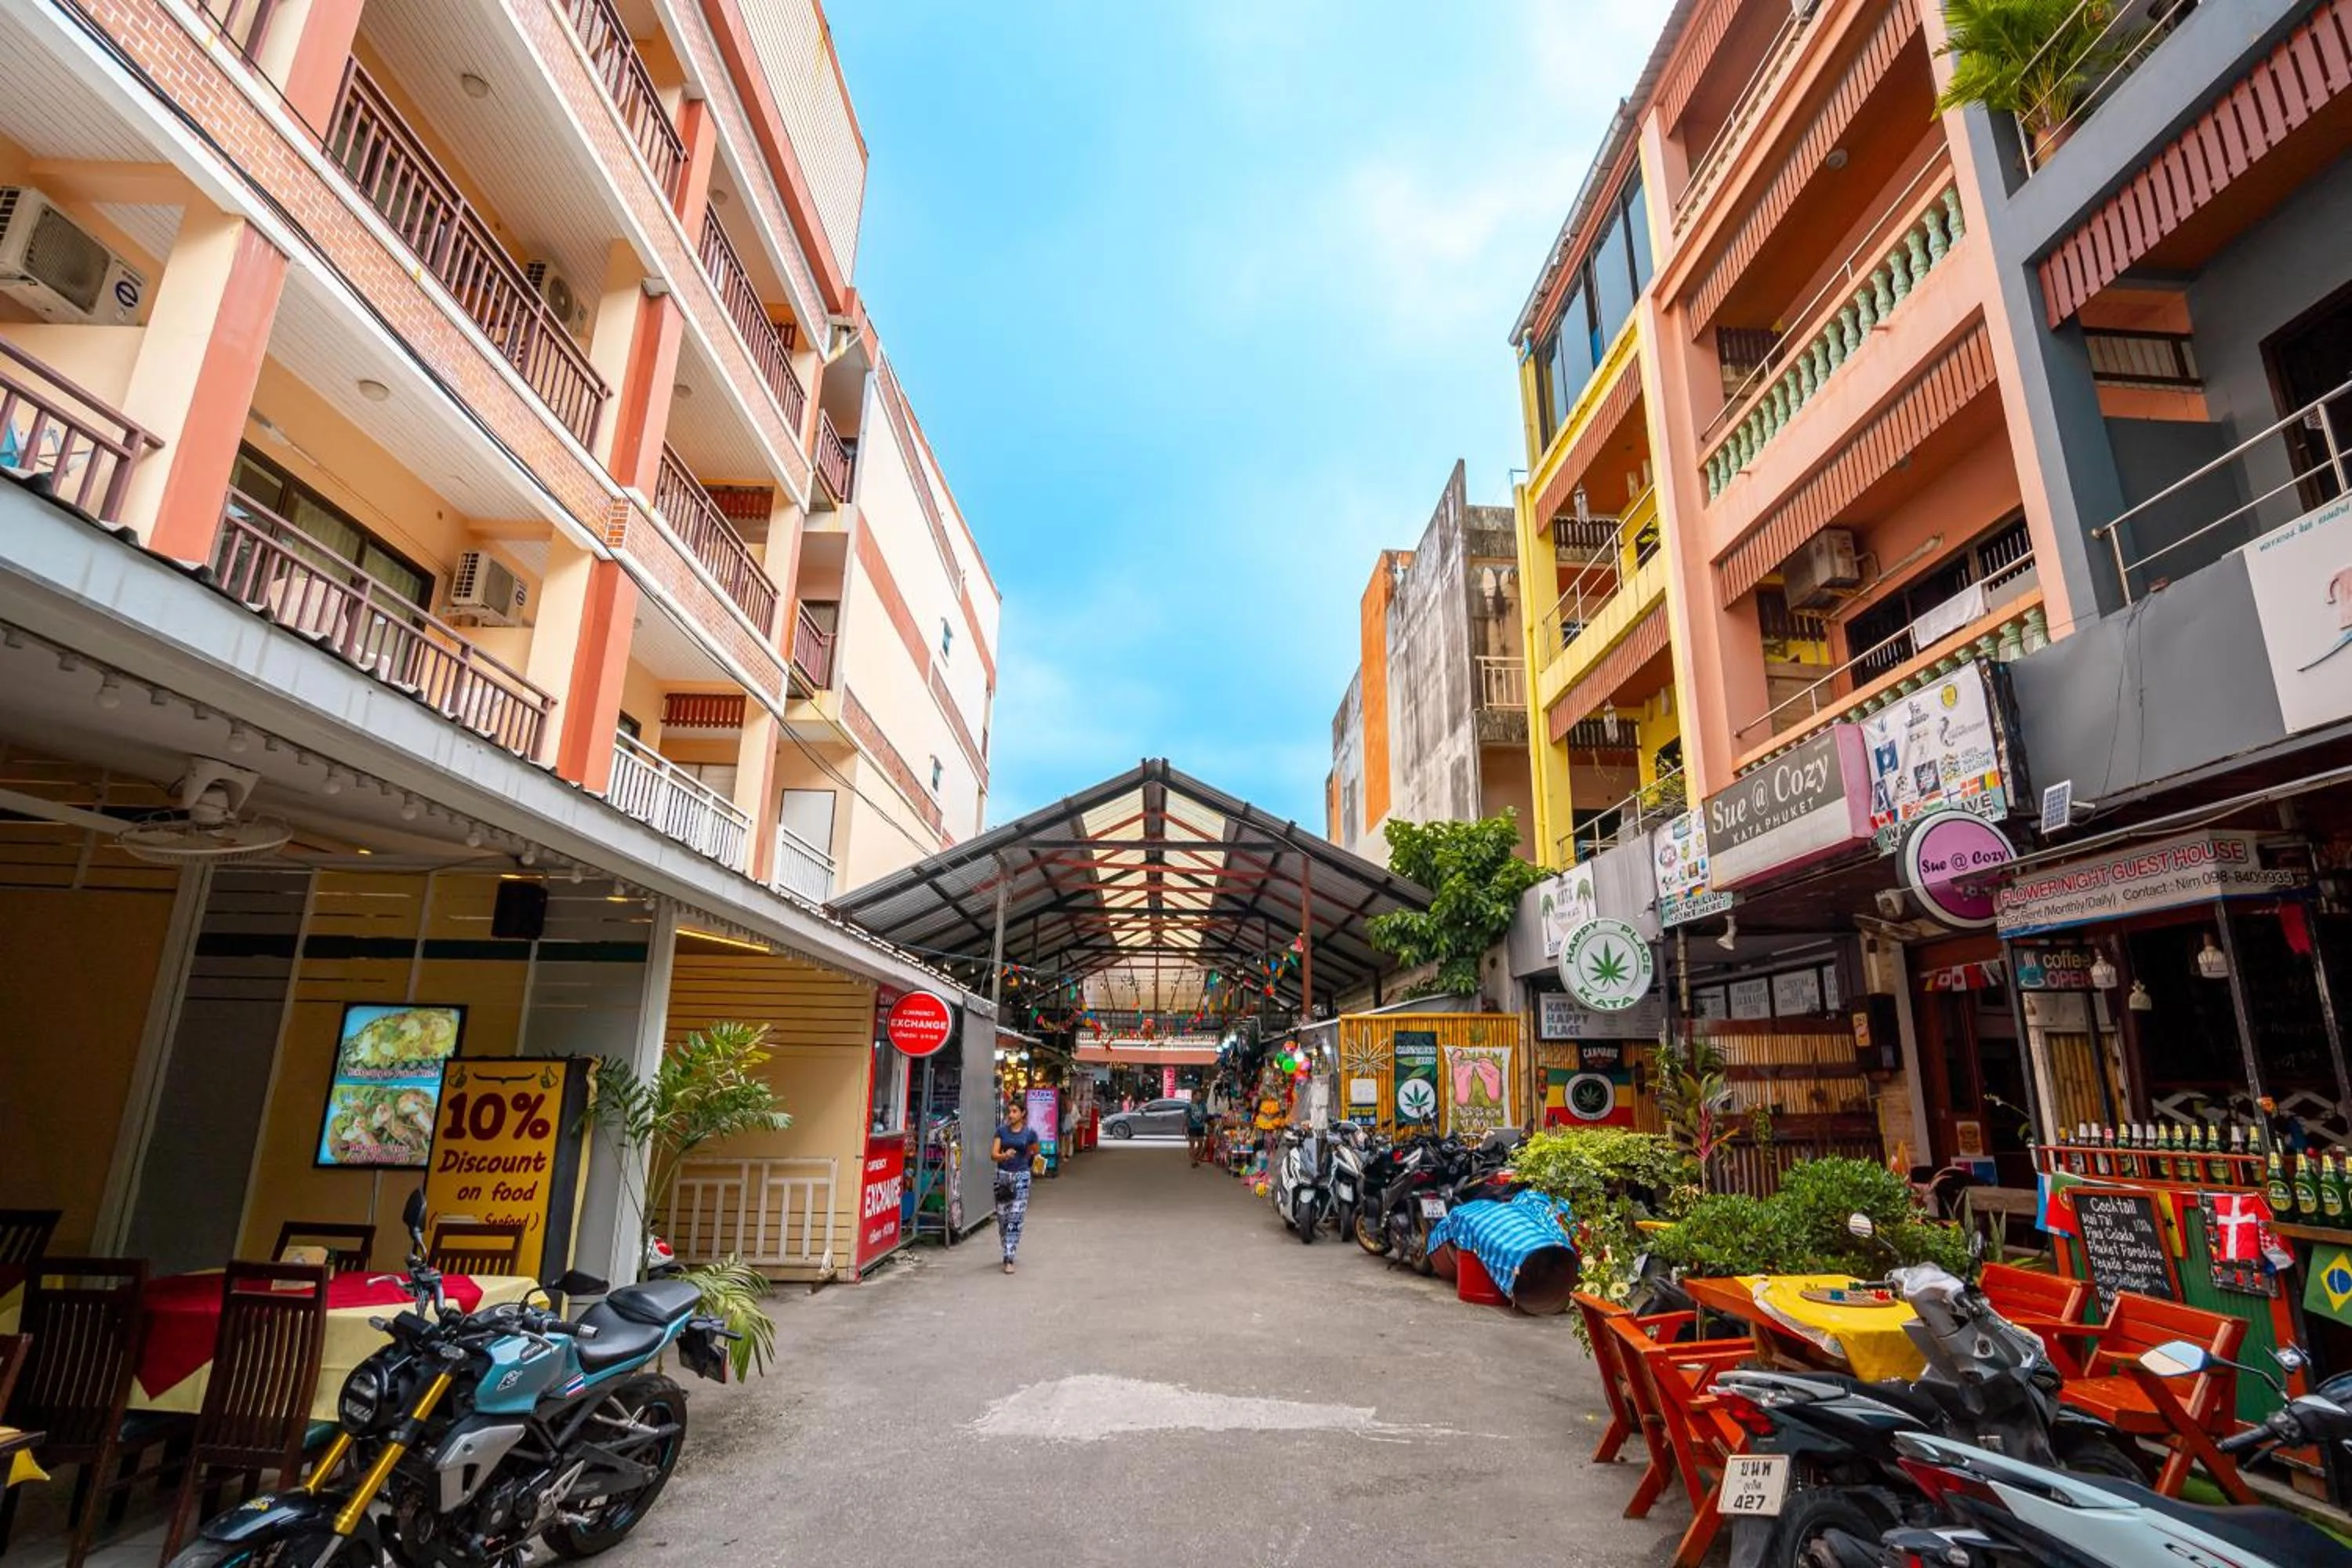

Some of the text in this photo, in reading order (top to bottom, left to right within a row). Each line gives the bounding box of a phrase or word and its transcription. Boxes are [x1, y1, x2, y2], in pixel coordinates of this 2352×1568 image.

[1712, 753, 1829, 834] Sue @ Cozy
[1732, 797, 1814, 845] KATA PHUKET
[1922, 850, 2006, 874] Sue @ Cozy
[2002, 840, 2245, 902] FLOWER NIGHT GUEST HOUSE
[1702, 891, 1725, 904] LIVE
[2122, 882, 2168, 902] Contact
[1566, 920, 1652, 975] HAPPY PLACE
[2042, 949, 2092, 969] coffee
[1545, 1000, 1575, 1012] KATA
[1578, 986, 1635, 1008] KATA
[890, 1018, 947, 1030] EXCHANGE
[1546, 1013, 1590, 1025] HAPPY
[1547, 1024, 1582, 1036] PLACE
[442, 1091, 551, 1142] 10%
[437, 1149, 547, 1174] Discount
[457, 1180, 539, 1202] on food
[865, 1176, 902, 1219] EXCHANGE
[2089, 1193, 2137, 1214] Cocktail
[1733, 1494, 1766, 1511] 427
